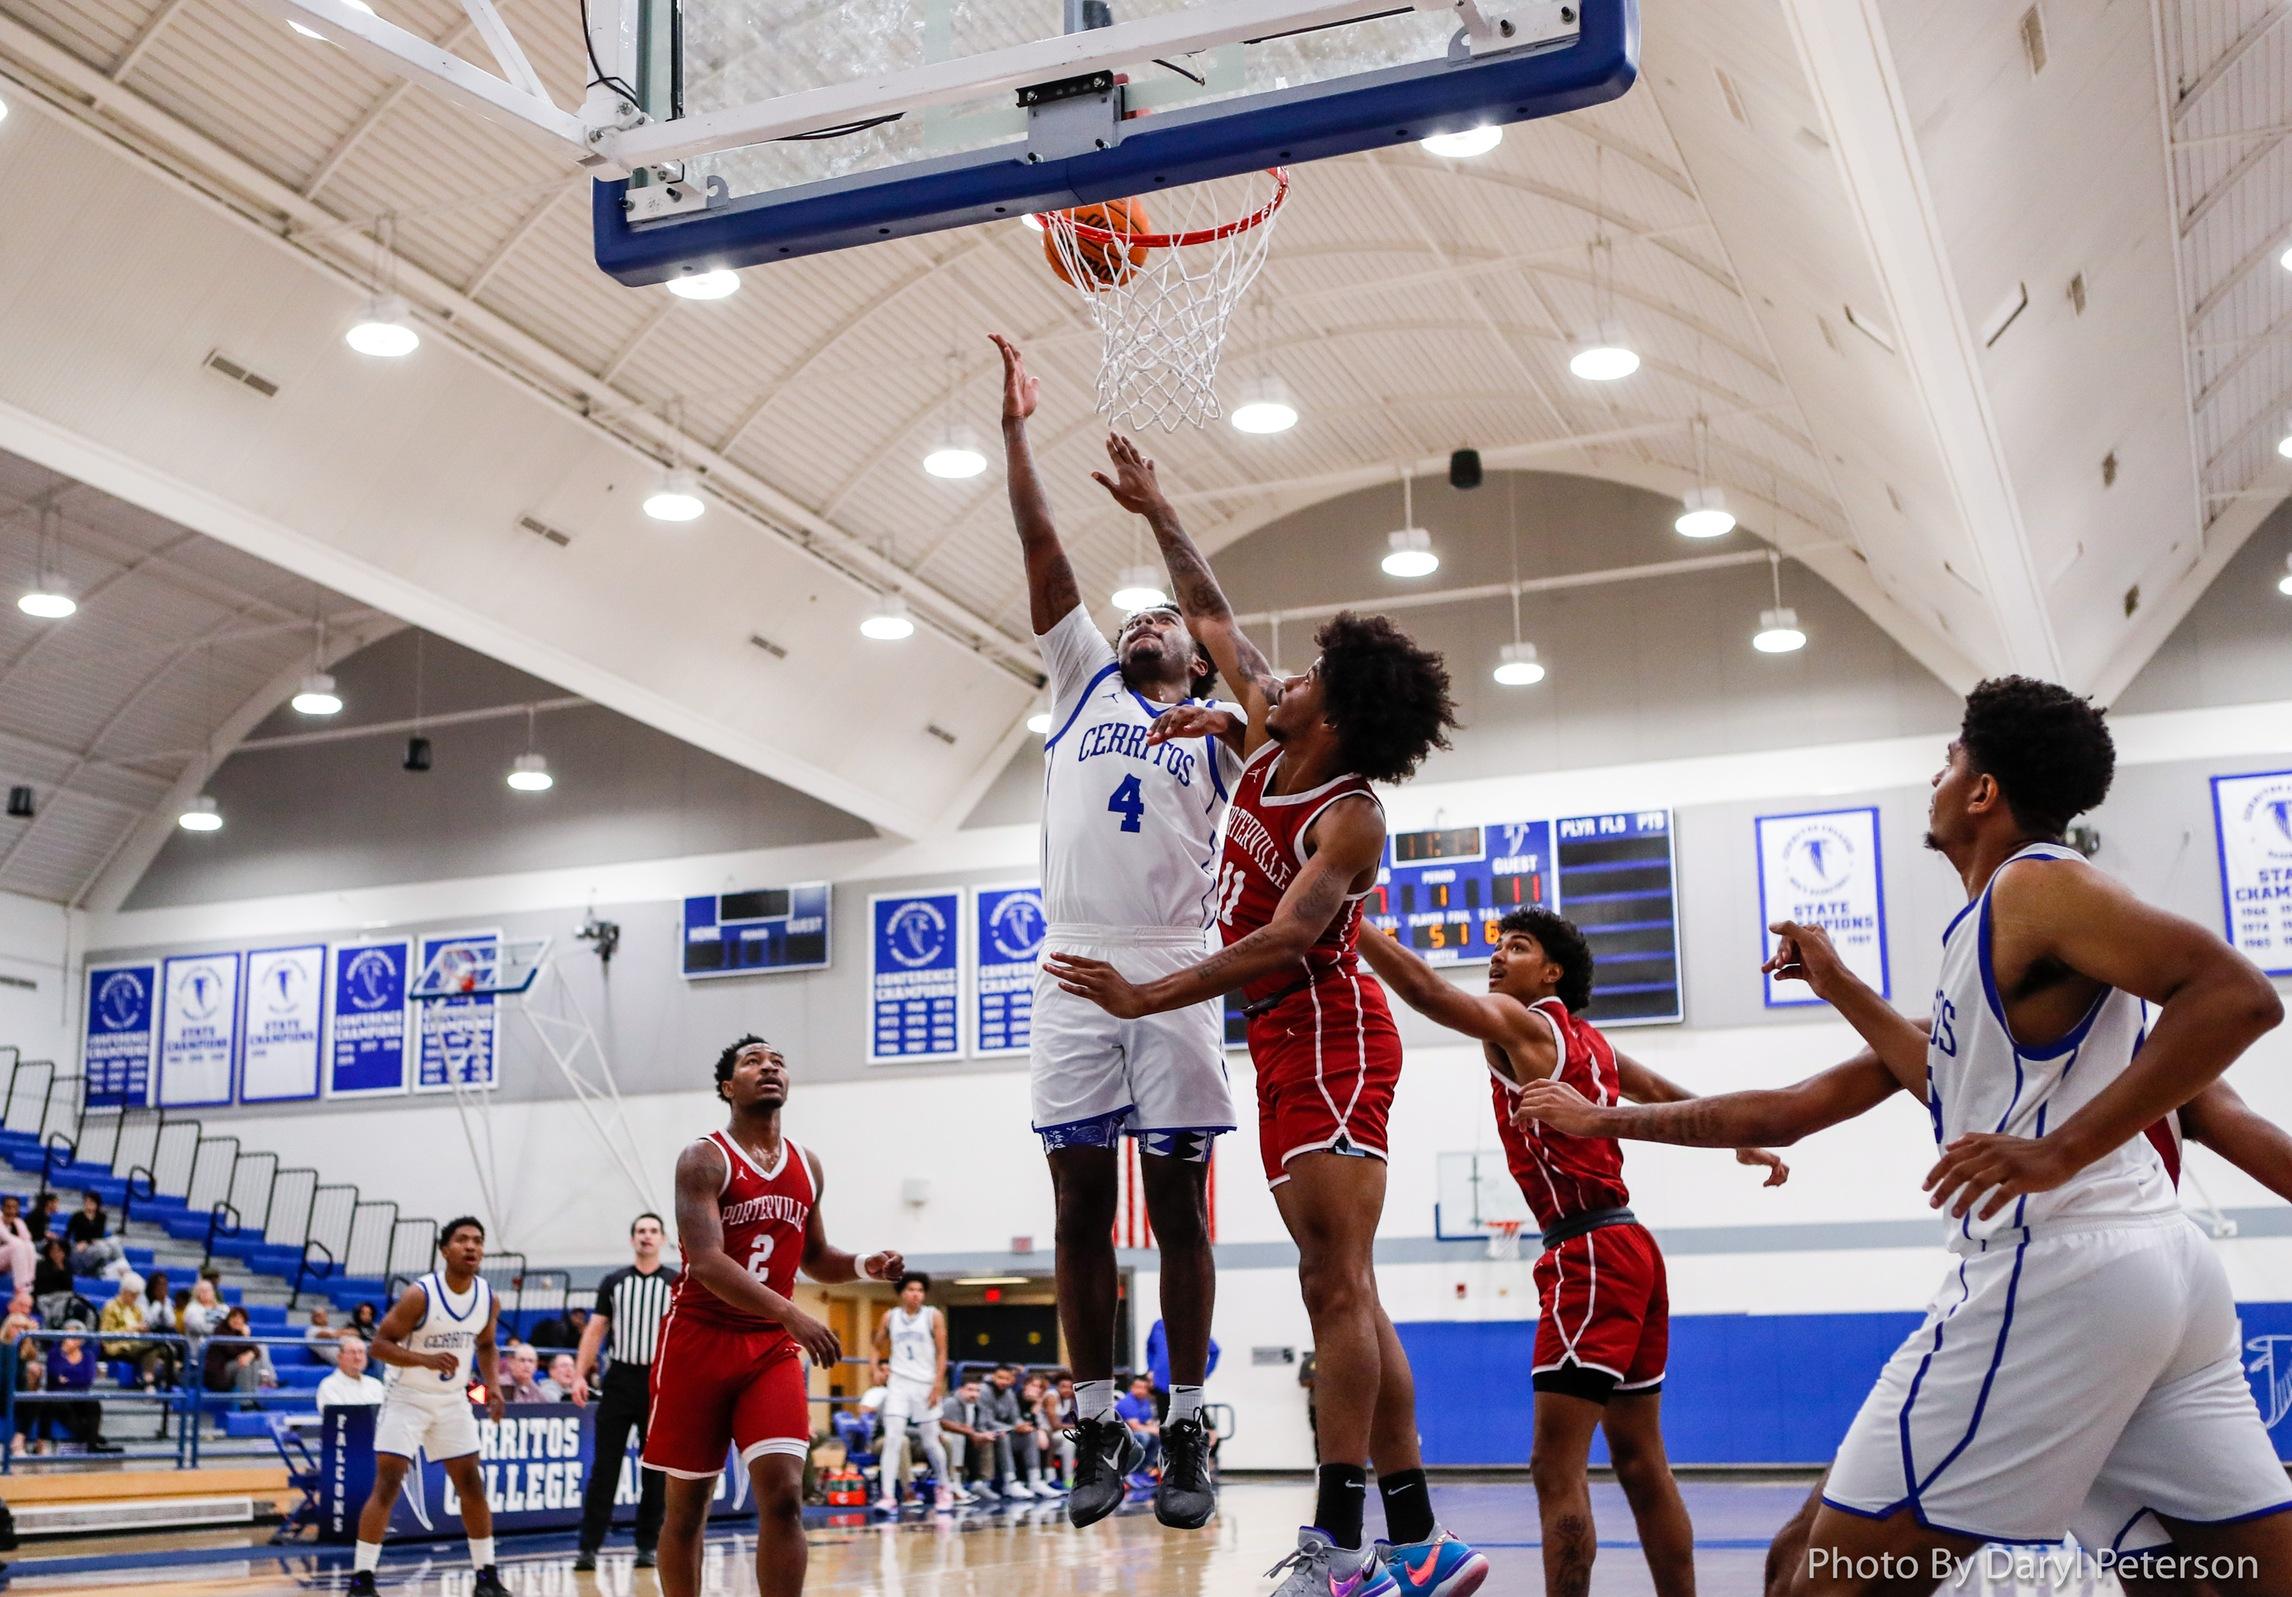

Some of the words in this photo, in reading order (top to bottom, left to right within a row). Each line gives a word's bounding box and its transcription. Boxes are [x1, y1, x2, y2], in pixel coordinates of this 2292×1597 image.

[1078, 722, 1195, 787] CERRITOS
[1107, 773, 1144, 833] 4
[1492, 855, 1538, 875] GUEST
[1512, 874, 1540, 905] 11
[1216, 861, 1246, 926] 11
[1794, 901, 1849, 916] STATE
[1429, 923, 1445, 949] 5
[746, 1234, 774, 1282] 2
[333, 1413, 348, 1532] FALCONS
[444, 1461, 583, 1516] CLLEGE
